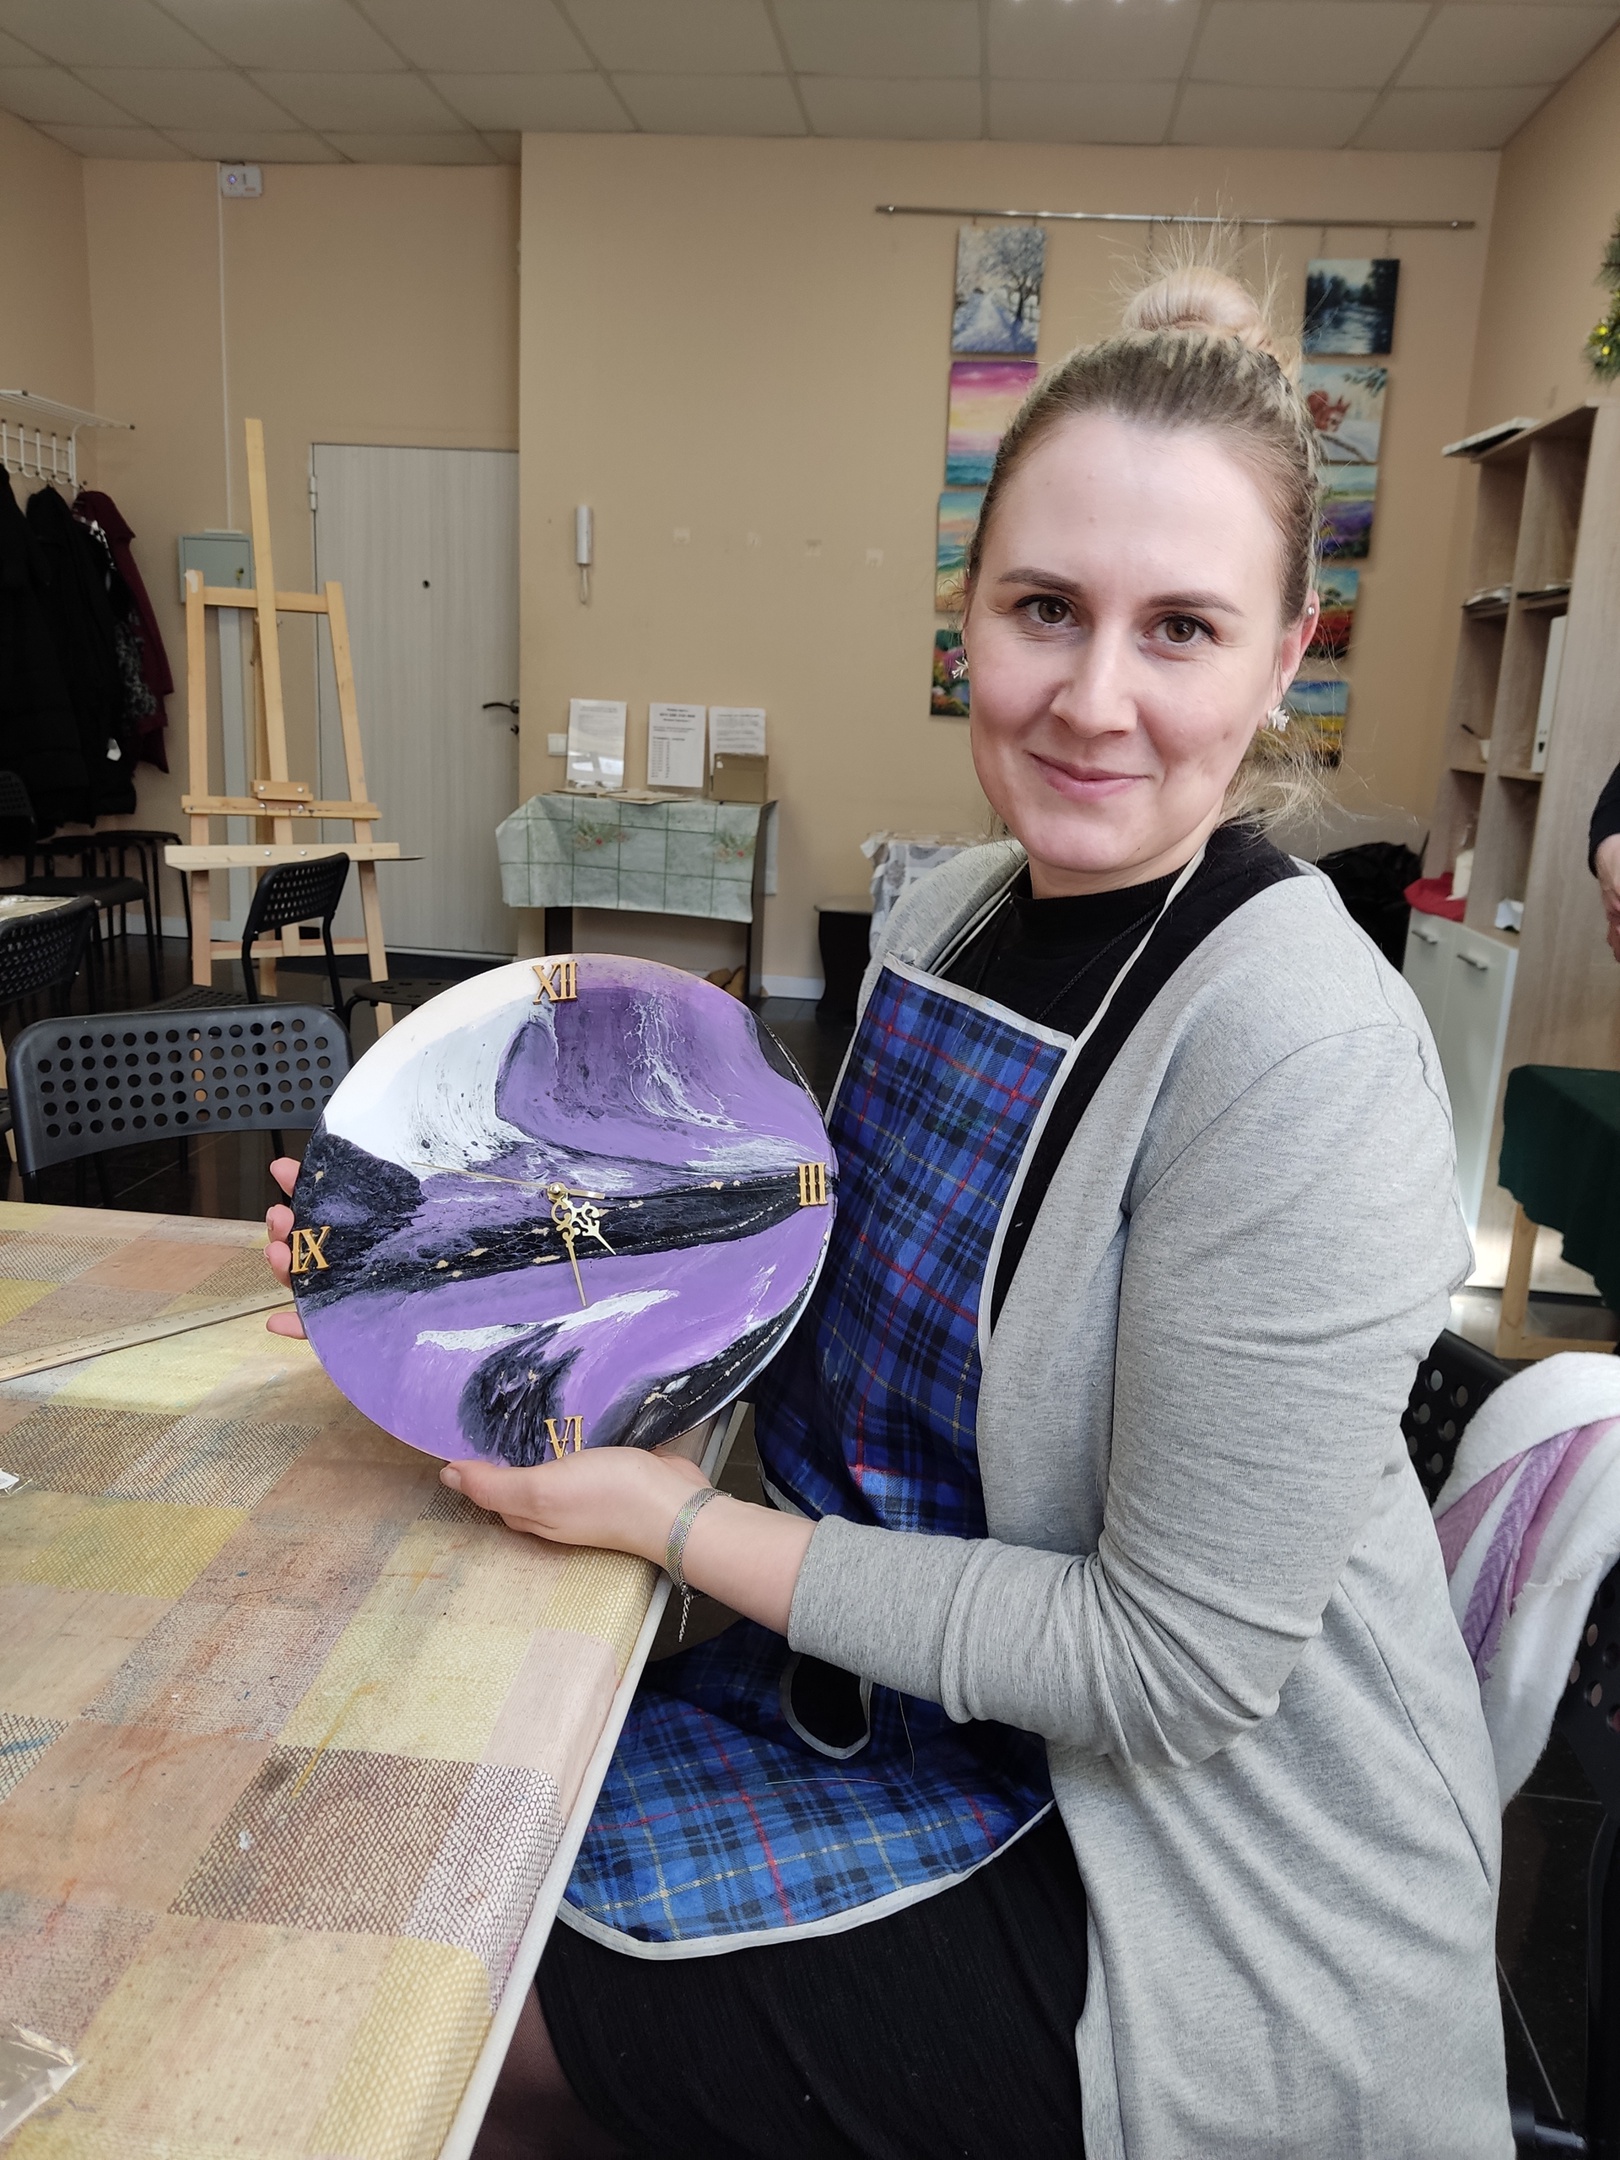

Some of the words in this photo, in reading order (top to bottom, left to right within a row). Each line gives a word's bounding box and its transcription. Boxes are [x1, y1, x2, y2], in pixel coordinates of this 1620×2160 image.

[532, 961, 578, 1005] XII
[798, 1162, 828, 1206] III
[290, 1226, 331, 1273] IX
[544, 1416, 584, 1459] VI
